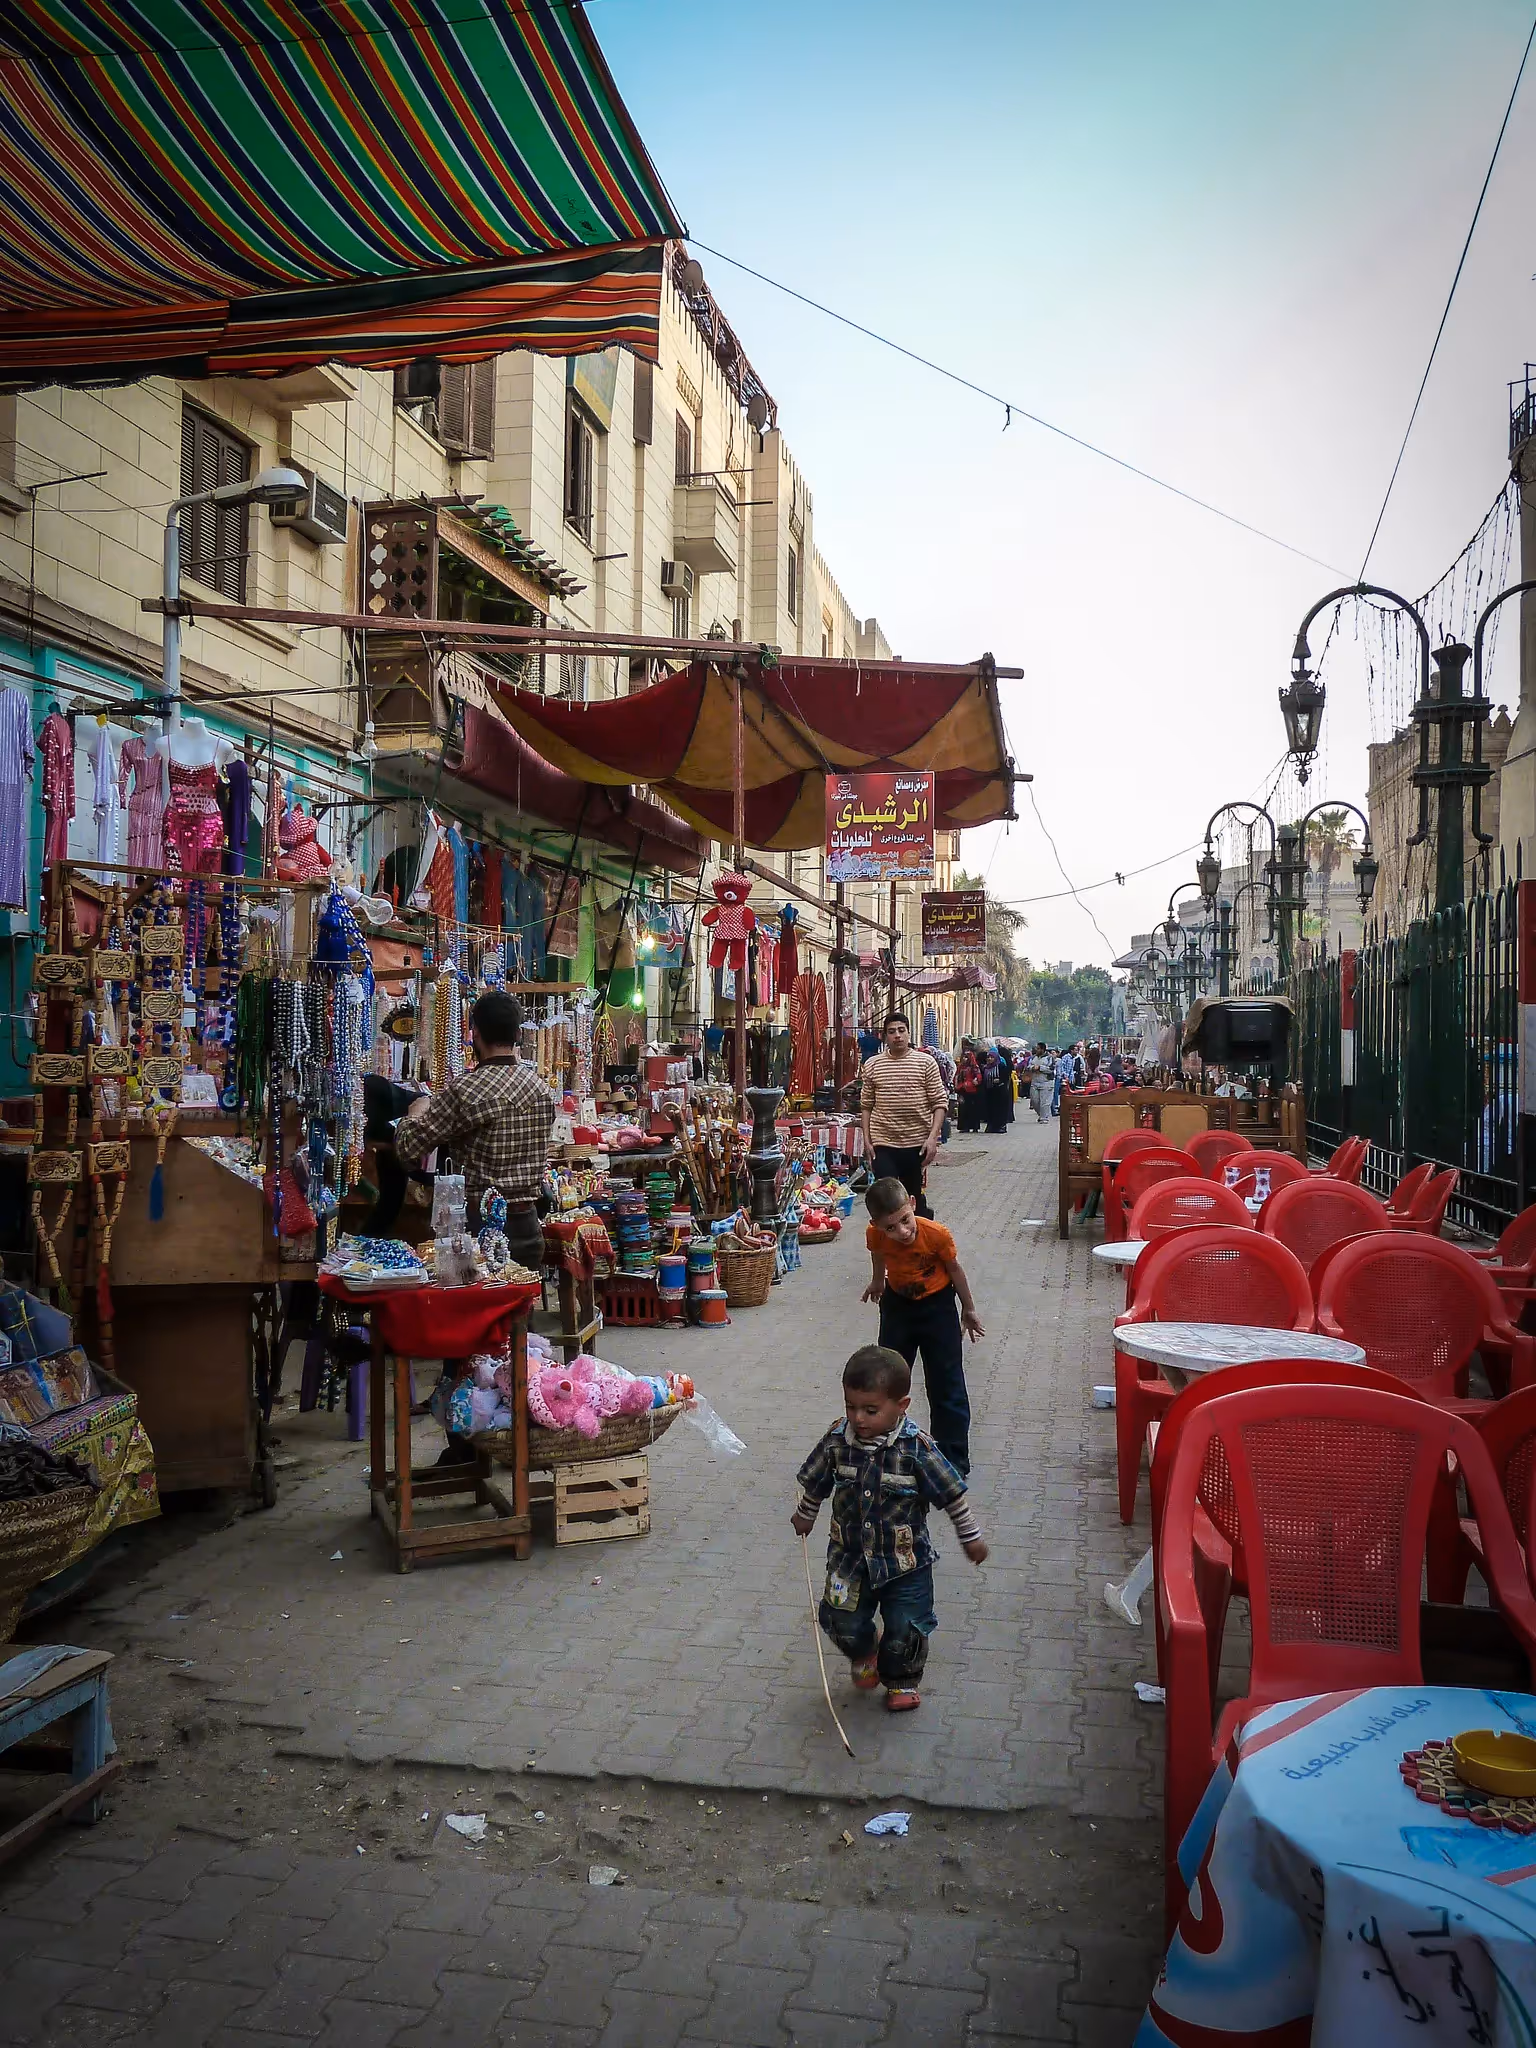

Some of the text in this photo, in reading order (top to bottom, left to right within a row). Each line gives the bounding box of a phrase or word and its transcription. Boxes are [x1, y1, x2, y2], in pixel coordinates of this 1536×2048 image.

[836, 794, 928, 831] الرشيدى
[830, 830, 872, 852] للحلويات
[1280, 1699, 1432, 1780] مياه شرب طبيعية
